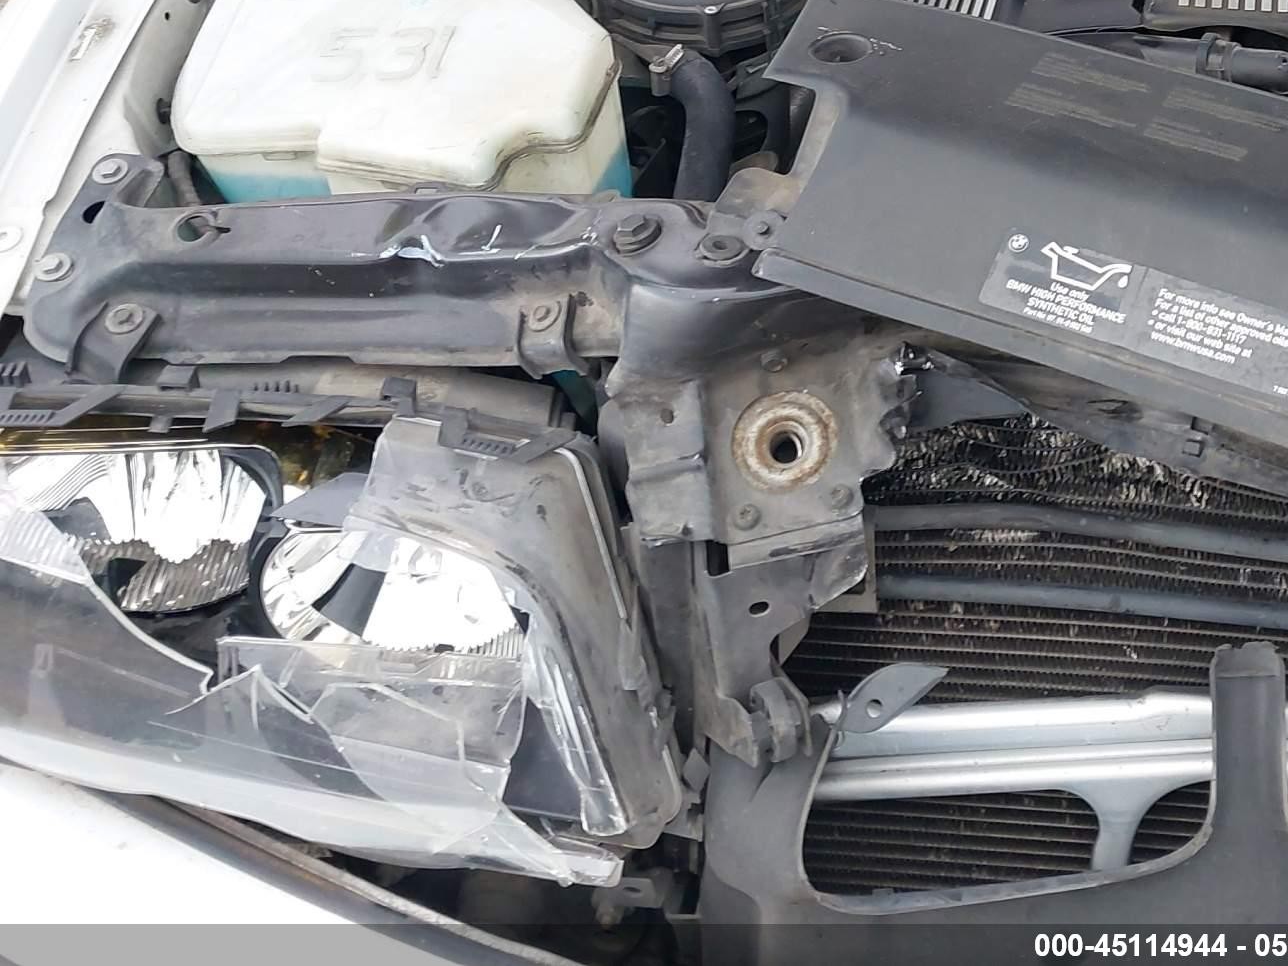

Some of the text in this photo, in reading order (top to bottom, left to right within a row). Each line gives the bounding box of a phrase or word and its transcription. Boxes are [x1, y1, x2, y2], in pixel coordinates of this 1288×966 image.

[1006, 279, 1126, 323] BMW HIGH PERFORMANCE
[1051, 282, 1090, 302] Use only
[1158, 288, 1176, 300] For
[1176, 295, 1201, 309] more
[1200, 301, 1219, 314] info
[1219, 308, 1236, 320] see
[1027, 298, 1095, 325] SYNTHETIC OIL
[1155, 298, 1170, 310] For
[1179, 305, 1195, 318] list
[1195, 311, 1206, 321] of
[1205, 315, 1231, 329] other
[1230, 322, 1272, 342] approved
[1158, 312, 1176, 323] call
[1150, 331, 1236, 364] www.bmwusa.com
[1154, 321, 1253, 358] or visit our web site at
